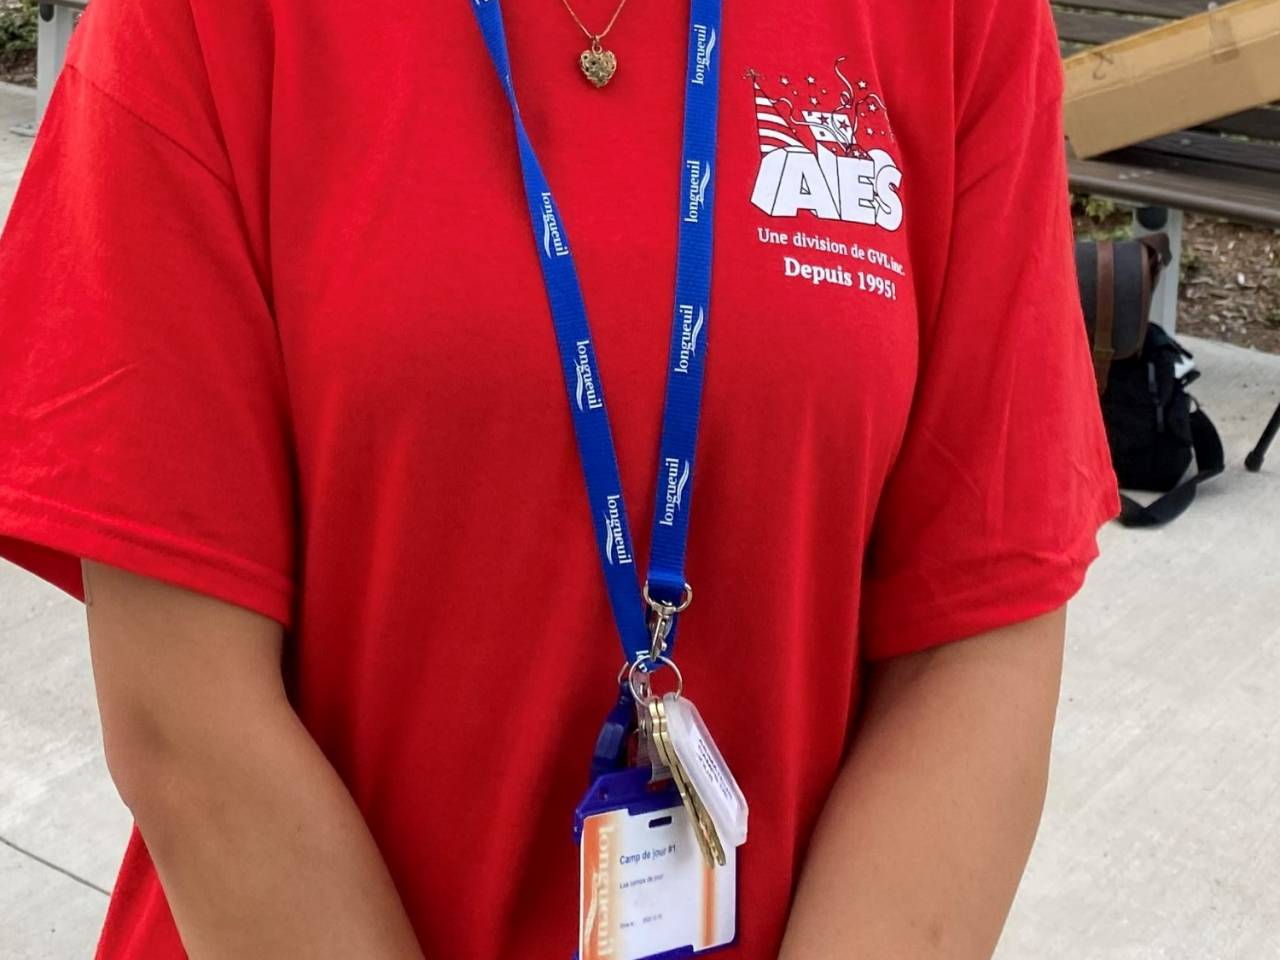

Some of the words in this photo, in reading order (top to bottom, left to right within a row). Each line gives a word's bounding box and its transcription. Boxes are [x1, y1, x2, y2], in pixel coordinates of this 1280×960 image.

[692, 24, 708, 85] longueuil
[684, 160, 701, 223] longueuil
[541, 192, 569, 257] longueuil
[757, 227, 788, 245] Une
[792, 232, 848, 256] division
[850, 243, 865, 260] de
[867, 248, 891, 270] GVL
[783, 256, 853, 287] Depuis
[857, 271, 897, 300] 1995!
[674, 304, 695, 374] longueuil
[576, 339, 603, 410] longueuil
[659, 457, 680, 527] longueuil
[606, 494, 633, 565] longueuil
[619, 854, 641, 865] Camp
[641, 850, 651, 860] de
[651, 847, 667, 861] jour
